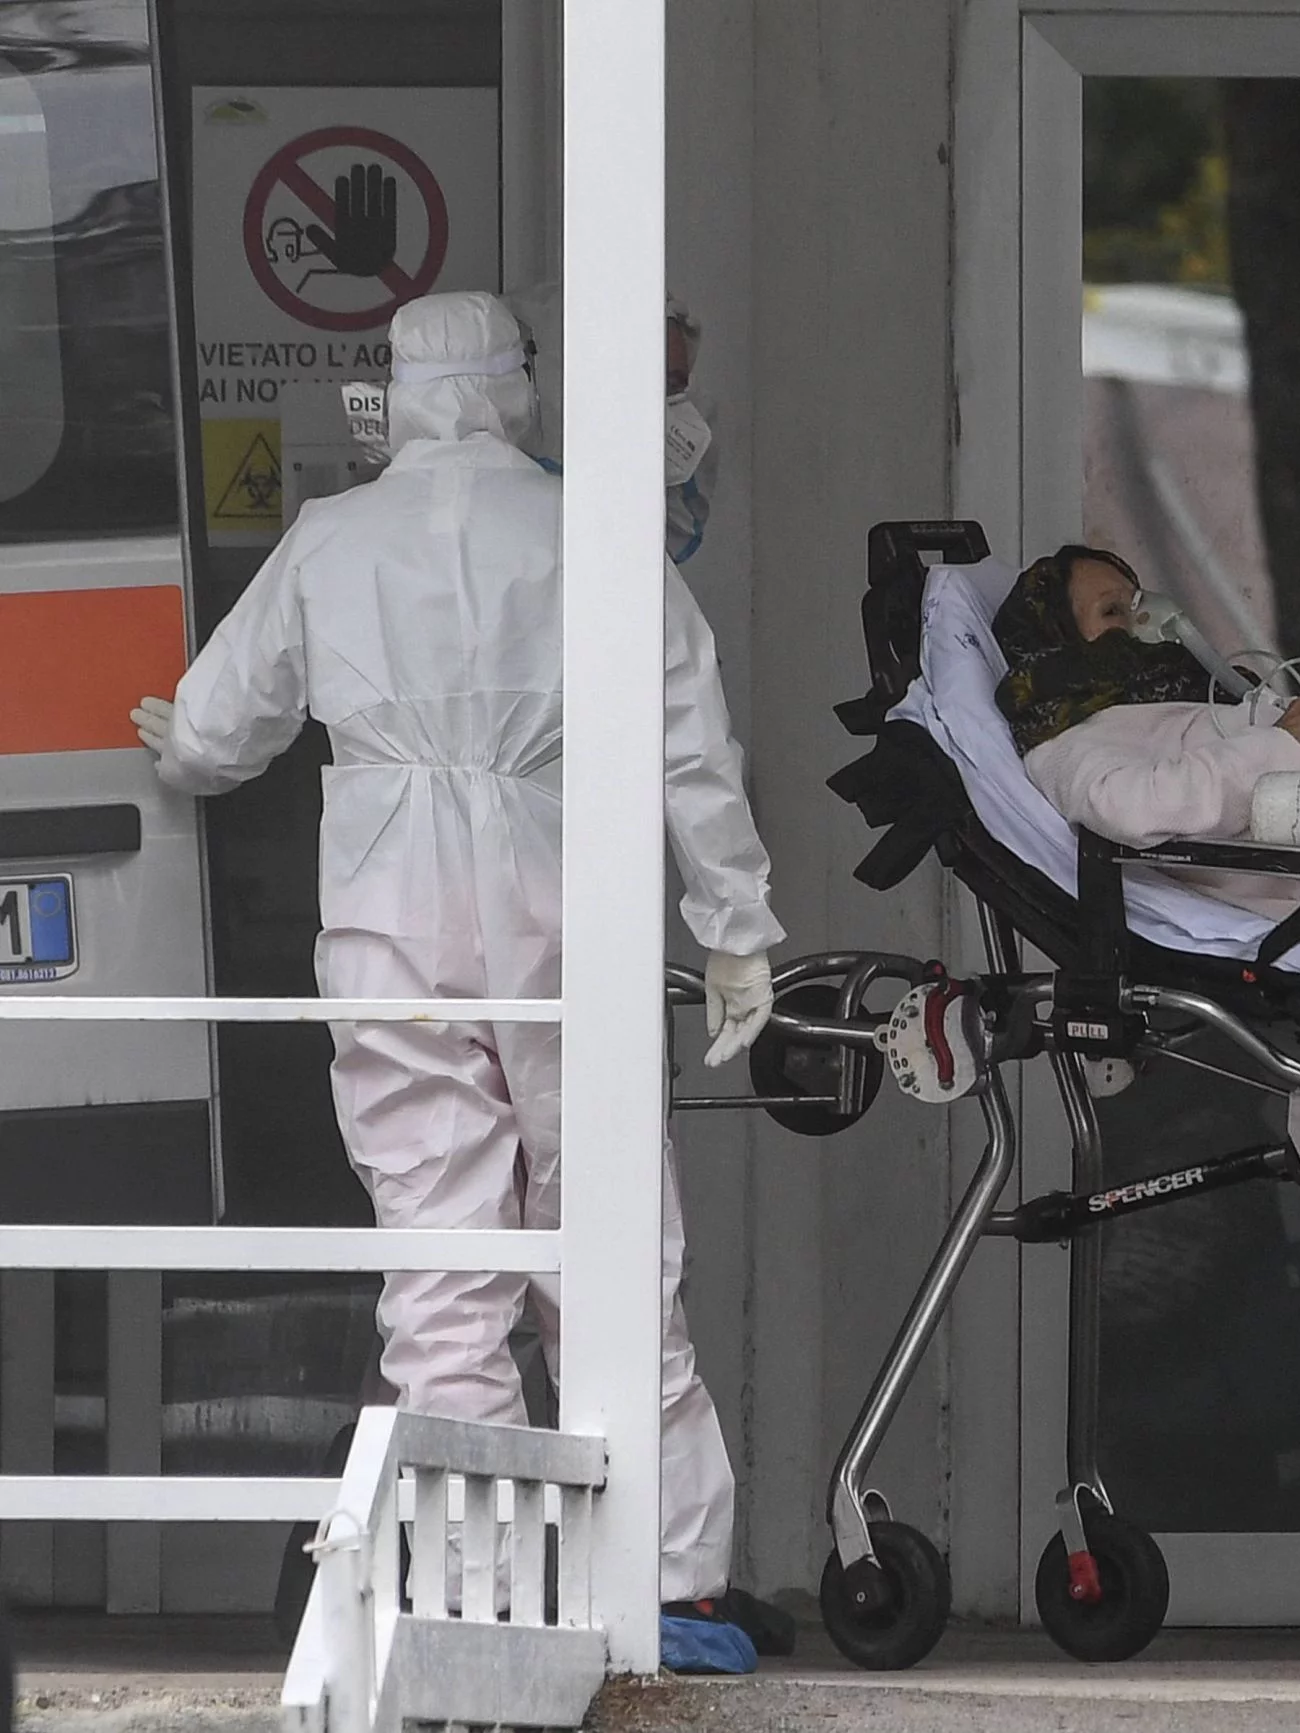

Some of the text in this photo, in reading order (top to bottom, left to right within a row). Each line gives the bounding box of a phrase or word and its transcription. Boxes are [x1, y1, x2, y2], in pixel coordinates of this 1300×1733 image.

[200, 343, 317, 367] VIETATO
[200, 378, 286, 402] AI NO
[349, 397, 382, 412] DIS
[1072, 1025, 1105, 1039] PULL
[1088, 1167, 1204, 1212] SPENCER
